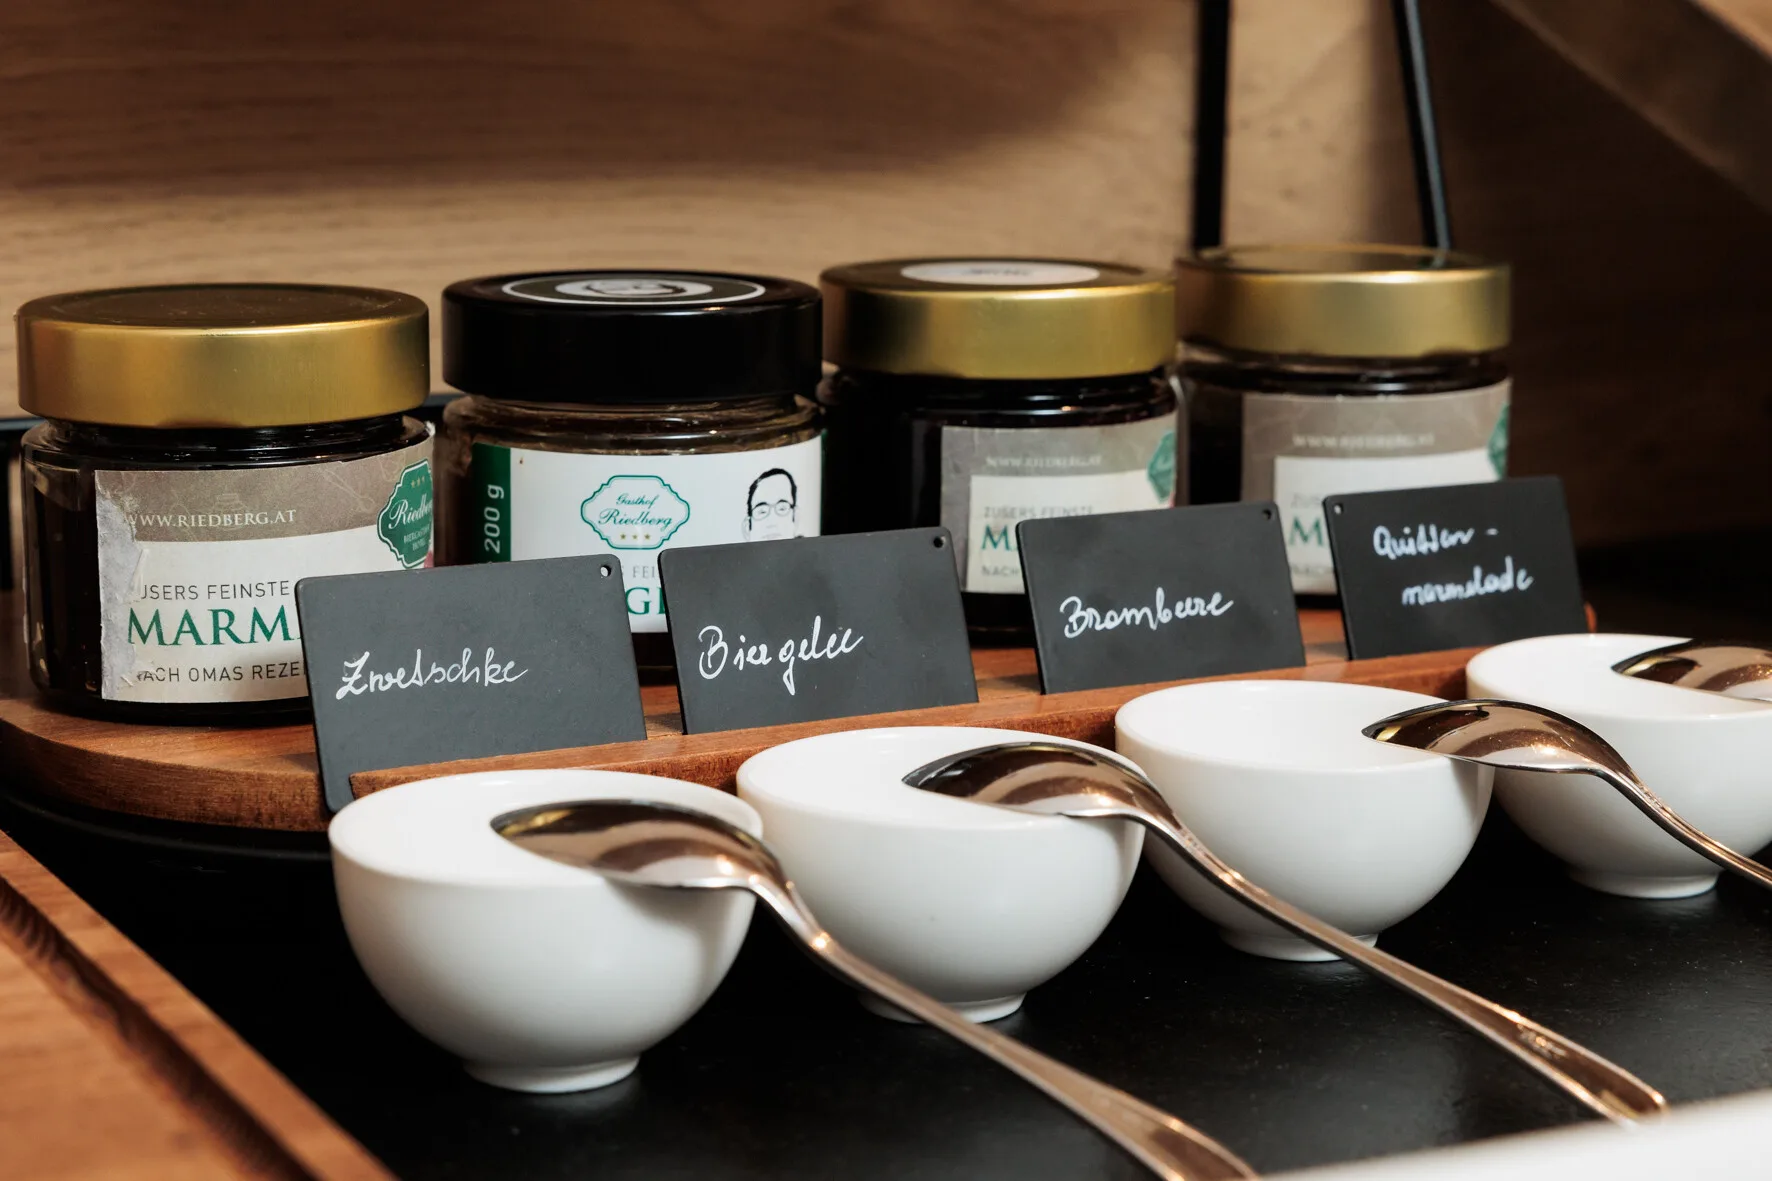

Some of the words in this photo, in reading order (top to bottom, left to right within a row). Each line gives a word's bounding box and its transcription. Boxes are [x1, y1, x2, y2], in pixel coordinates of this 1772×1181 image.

[487, 484, 504, 499] g
[616, 493, 659, 509] Gasthof
[484, 506, 500, 553] 200
[598, 508, 672, 531] Riedberg
[632, 565, 656, 579] FEI
[207, 580, 290, 599] FEINSTE
[1060, 587, 1234, 638] Brombeere
[128, 604, 303, 646] MARM
[188, 665, 243, 682] OMAS
[252, 660, 307, 681] REZE
